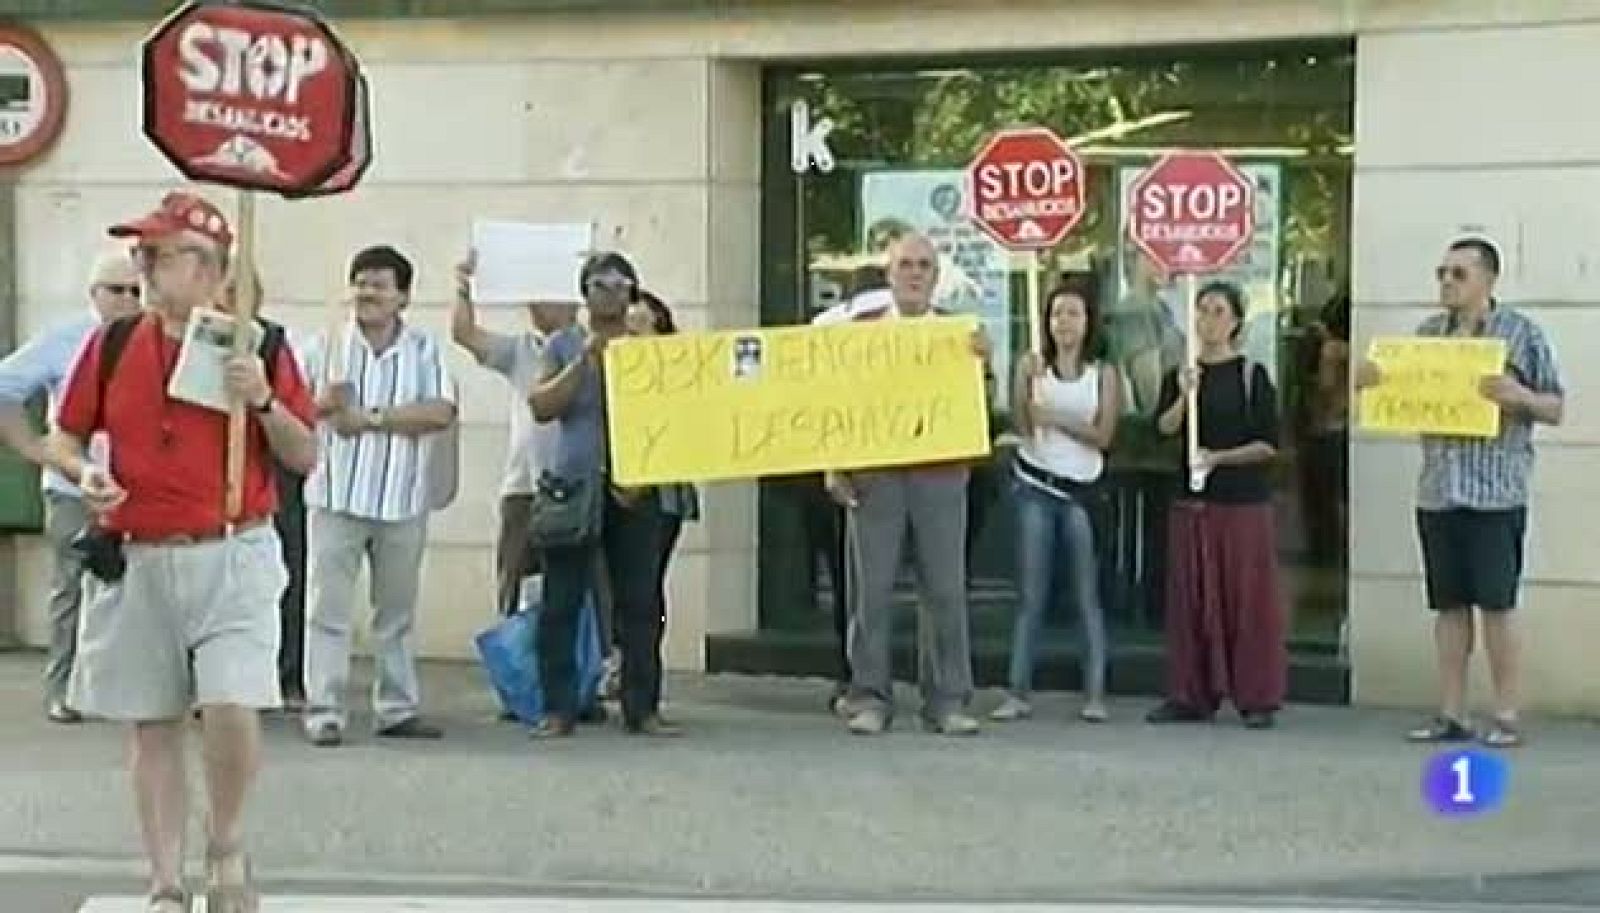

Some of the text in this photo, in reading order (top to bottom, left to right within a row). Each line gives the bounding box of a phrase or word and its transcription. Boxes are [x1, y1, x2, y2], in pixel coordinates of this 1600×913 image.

[178, 22, 328, 103] STOP
[978, 159, 1074, 200] STOP
[1142, 184, 1241, 220] STOP
